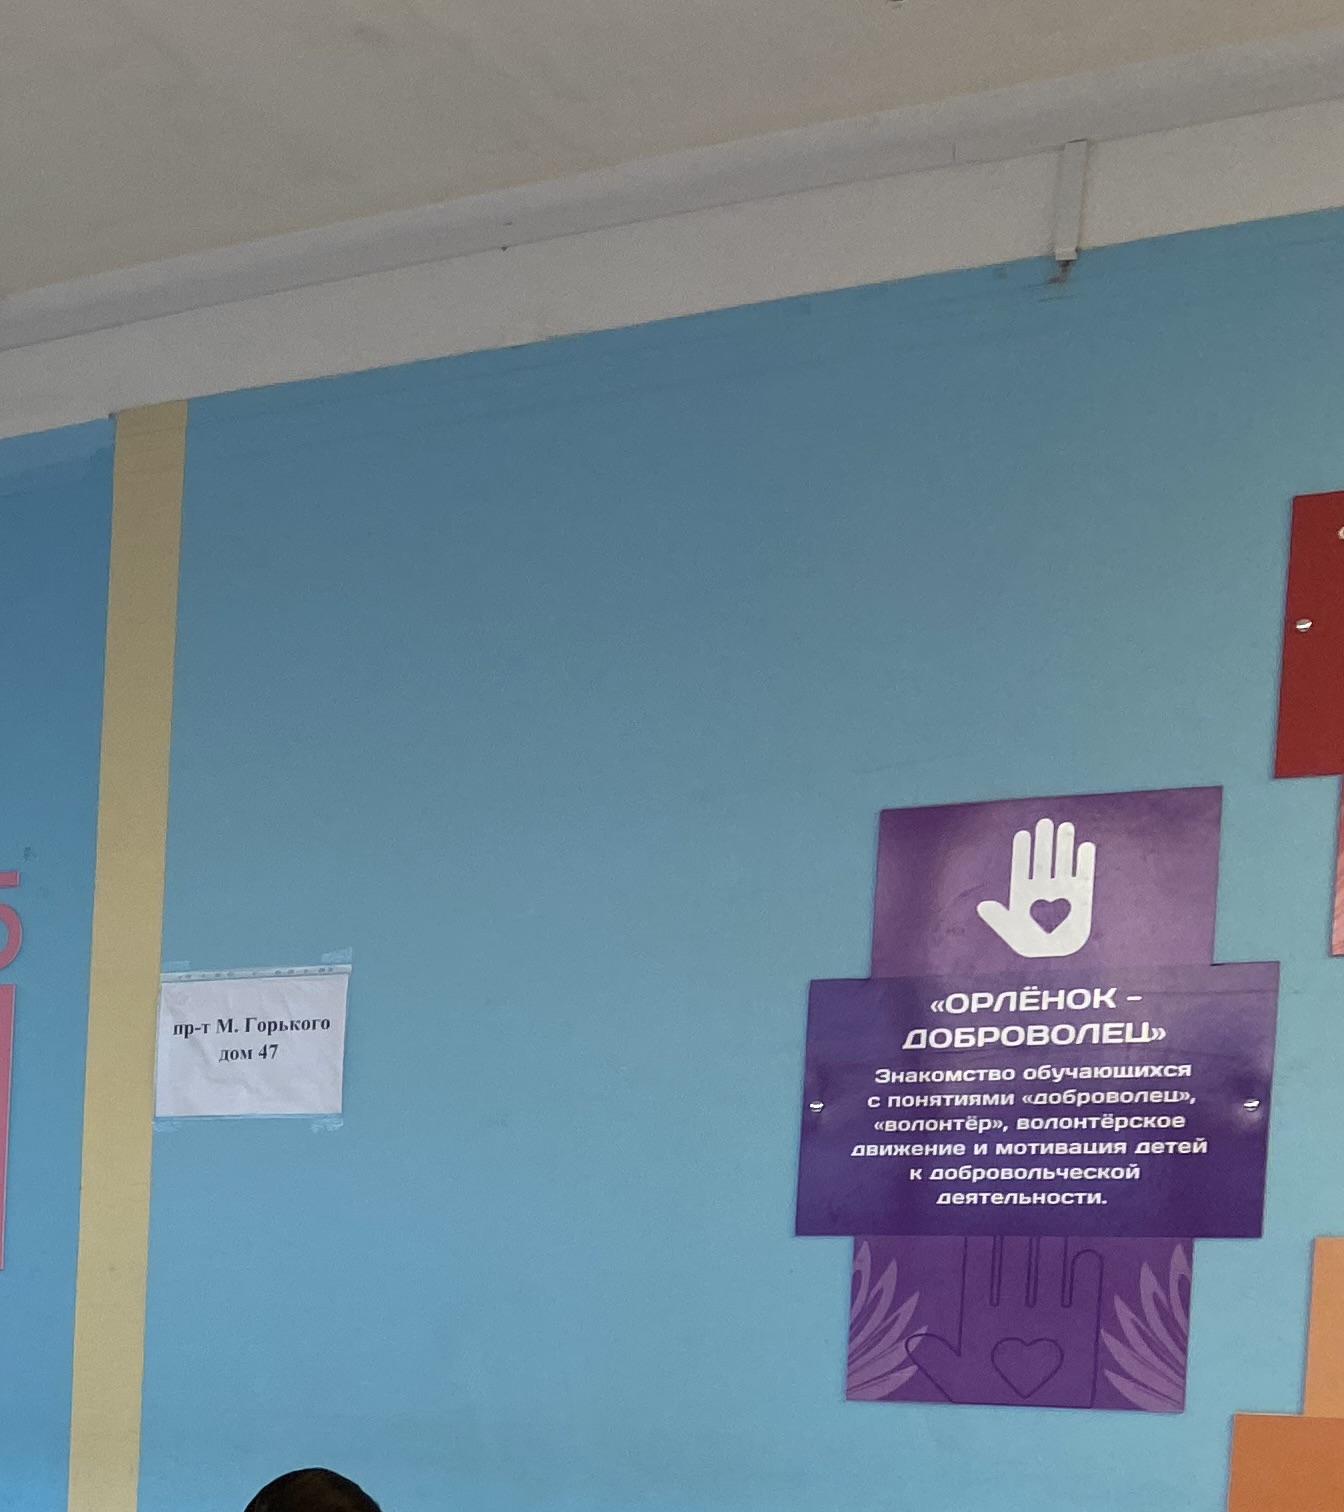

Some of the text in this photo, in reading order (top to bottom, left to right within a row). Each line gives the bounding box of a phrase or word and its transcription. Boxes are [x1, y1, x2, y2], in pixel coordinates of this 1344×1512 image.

[930, 986, 1117, 1015] «ОРЛЁНОК
[172, 1017, 331, 1039] пр-т М. Горького
[902, 1022, 1167, 1049] ДОБРОВОЛЕЦ»
[218, 1044, 279, 1062] дом 47
[874, 1064, 1192, 1084] Знакомство обучающихся
[867, 1089, 1197, 1108] с понятиями «доброволец»,
[874, 1113, 1187, 1133] «волонтёр», волонтёрское
[851, 1137, 1208, 1157] движение и мотивация детей
[910, 1163, 1141, 1182] к добровольческой
[936, 1191, 1107, 1206] деятельности.
